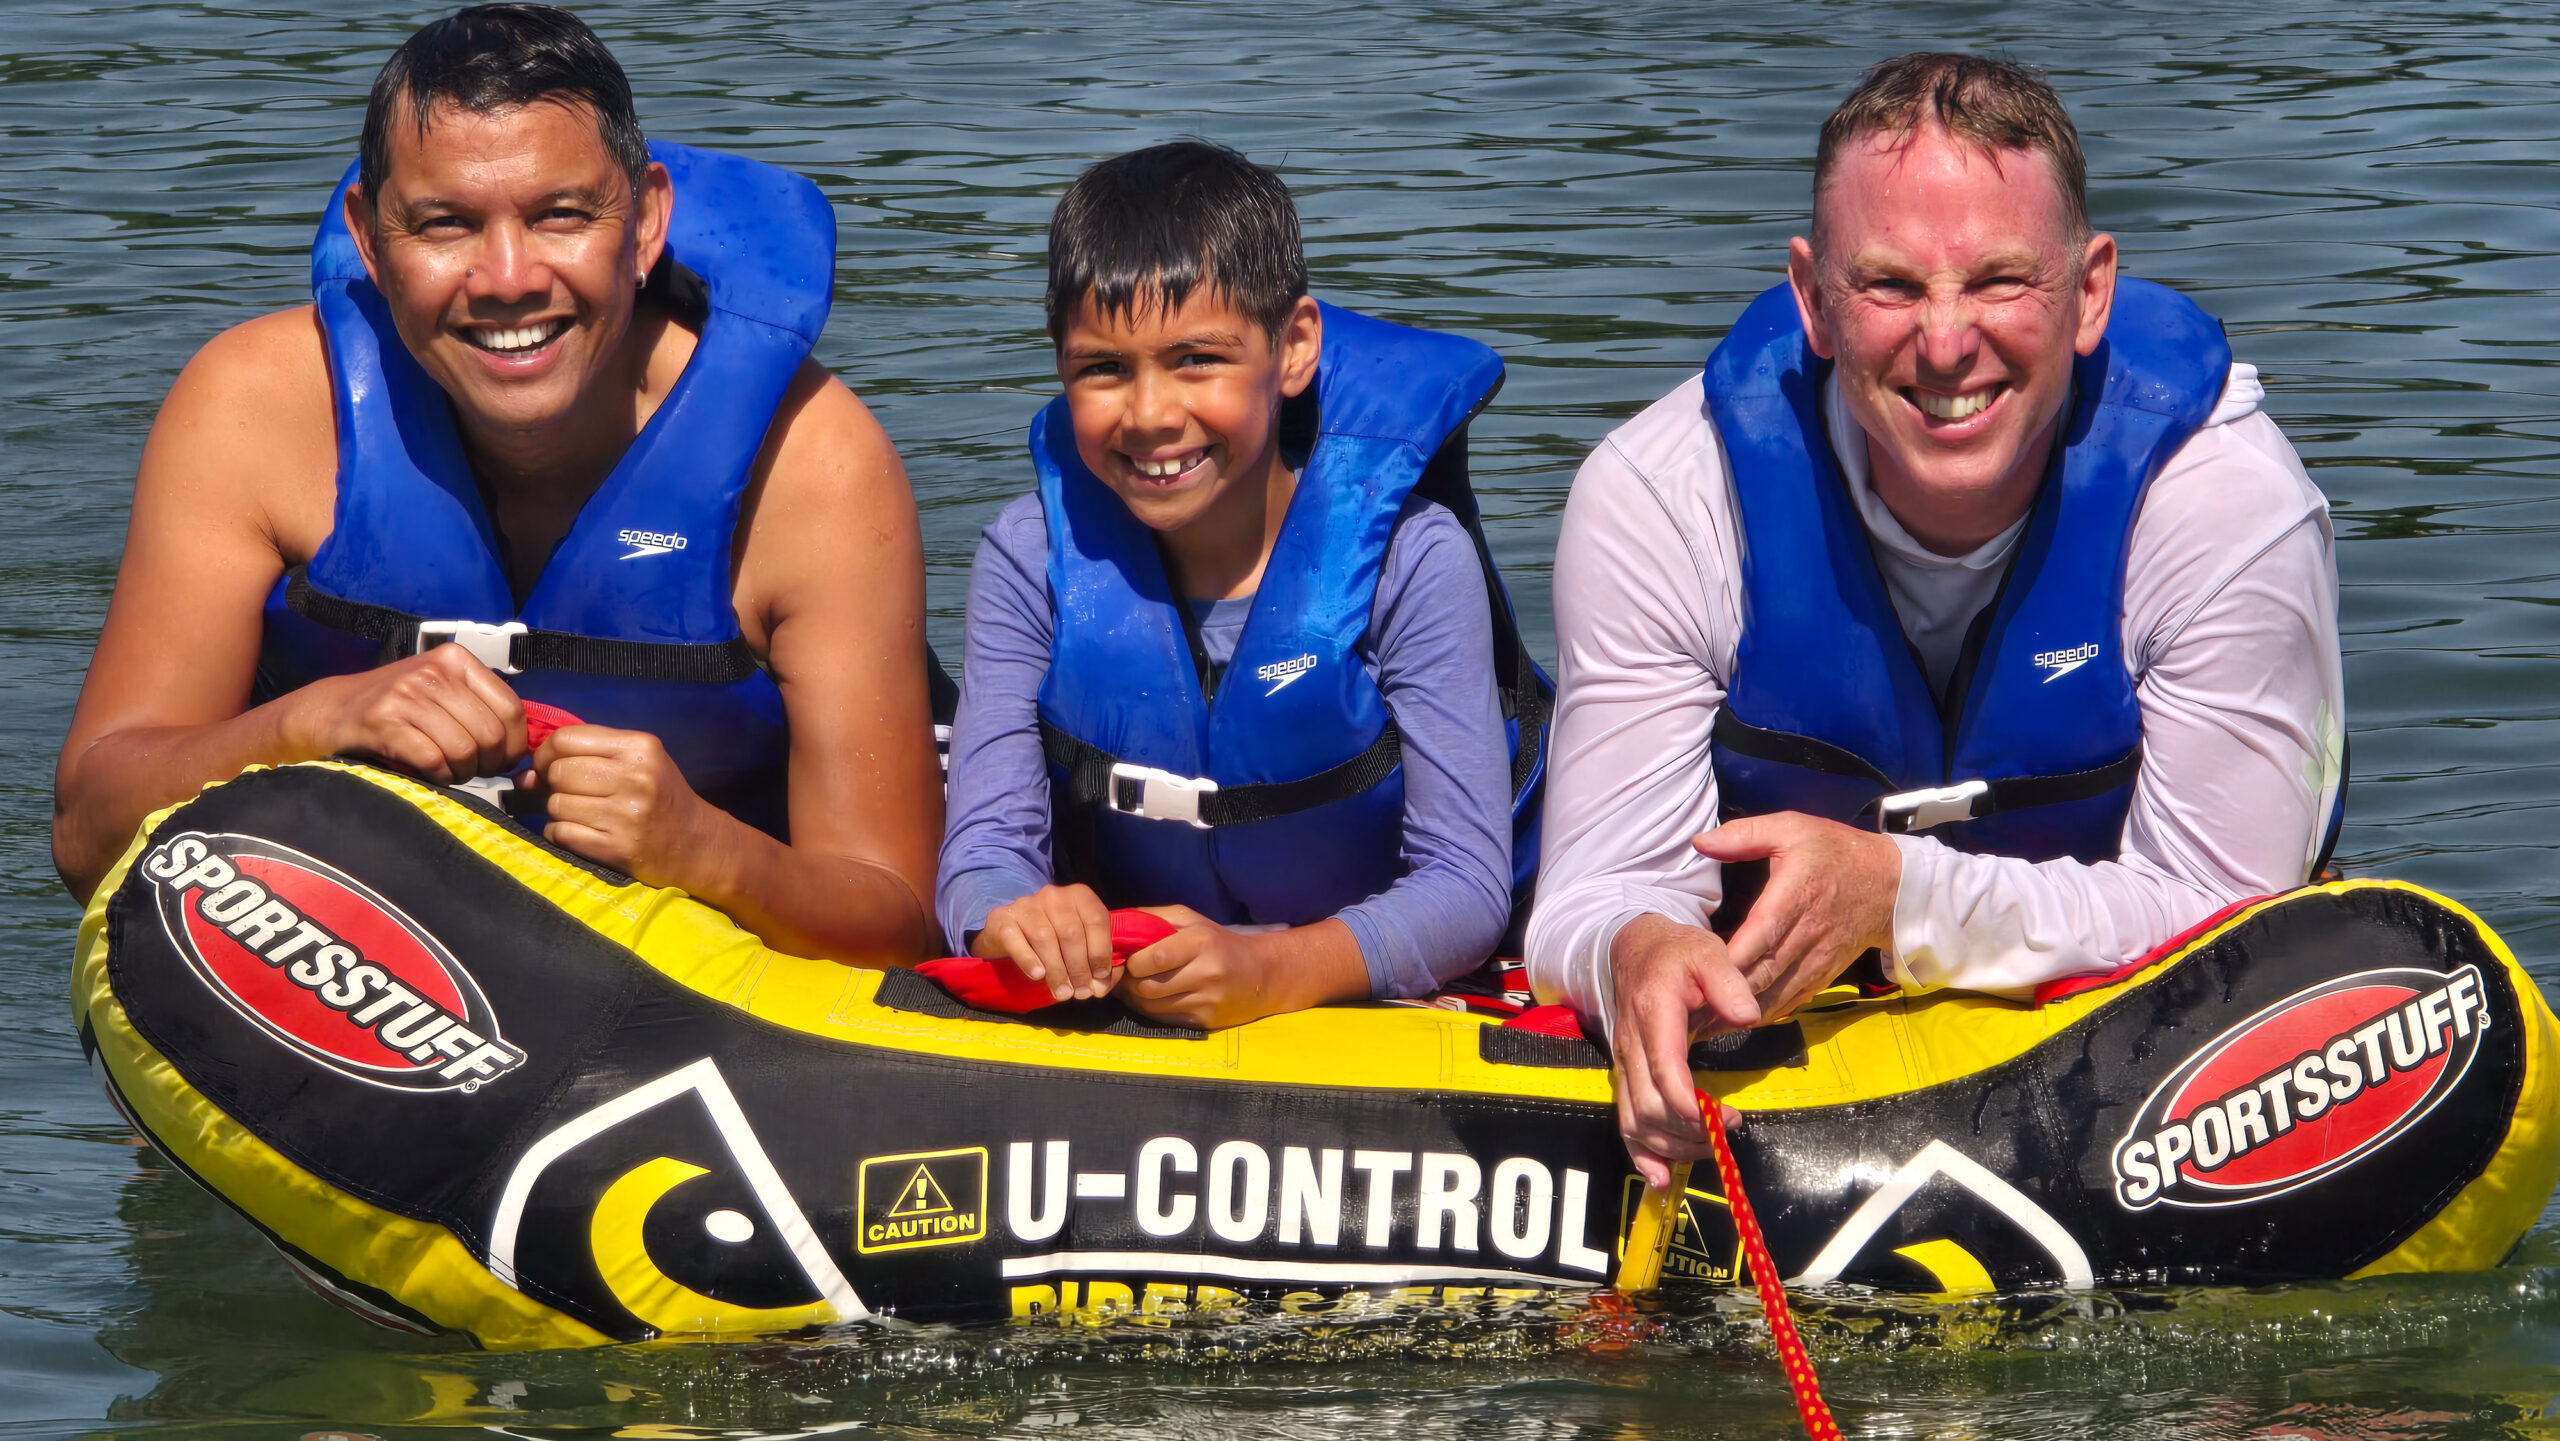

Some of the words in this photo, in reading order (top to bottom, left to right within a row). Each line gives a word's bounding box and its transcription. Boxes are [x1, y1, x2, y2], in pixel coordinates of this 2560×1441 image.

[618, 529, 687, 549] speedo
[1258, 653, 1317, 681] speedo
[2034, 642, 2099, 669] speedo
[149, 838, 516, 1080] SPORTSSTUFF
[2122, 974, 2479, 1201] SPORTSSTUFF
[1007, 1136, 1610, 1275] U-CONTROL
[868, 1213, 976, 1242] CAUTION
[1662, 1251, 1728, 1278] UTION
